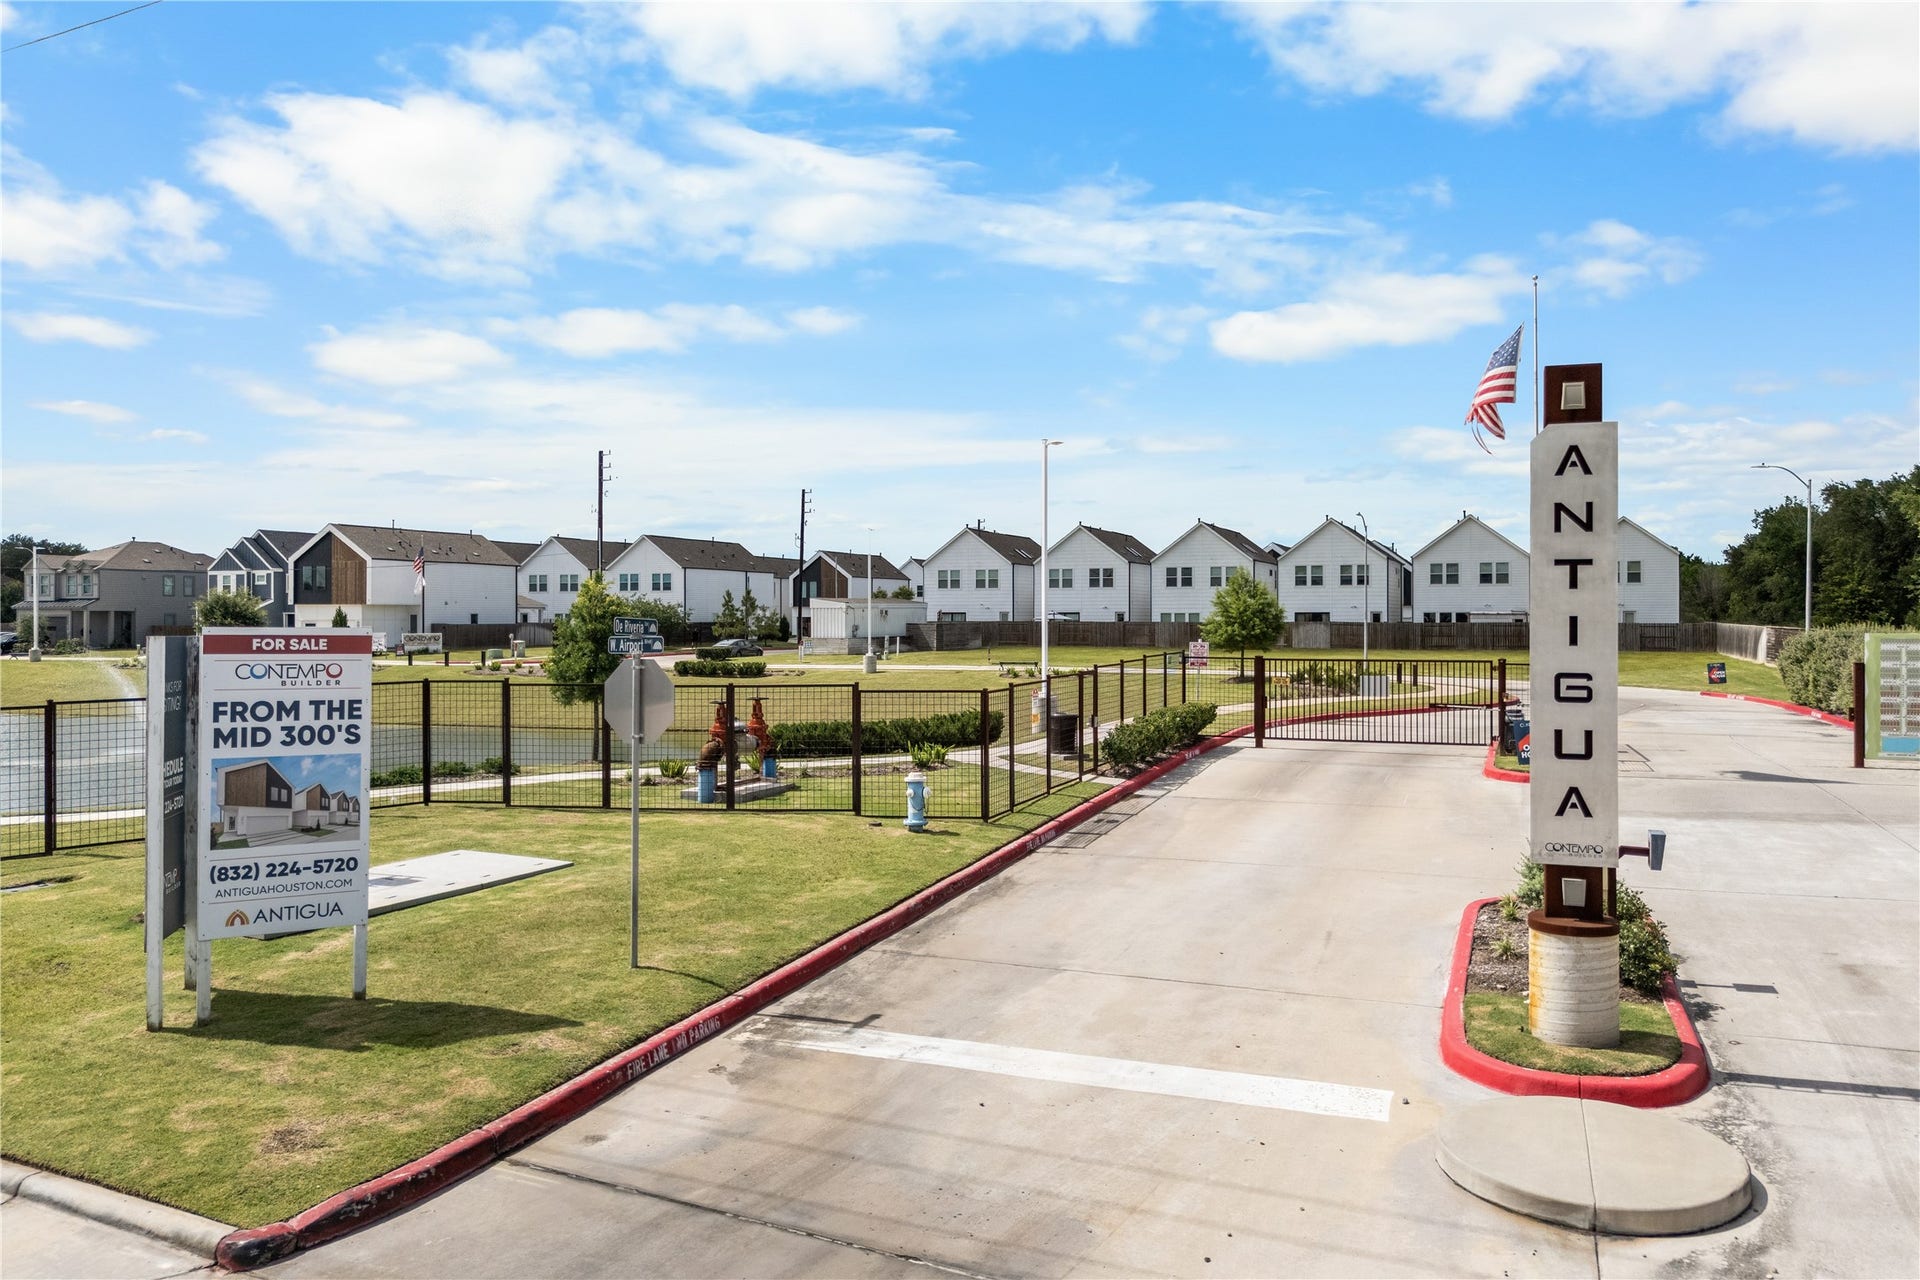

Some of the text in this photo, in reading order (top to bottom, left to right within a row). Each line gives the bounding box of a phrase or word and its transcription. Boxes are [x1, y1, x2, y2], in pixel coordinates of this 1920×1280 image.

[615, 620, 623, 633] De
[1554, 445, 1593, 818] ANTIGUA
[252, 638, 328, 651] FOR SALE
[610, 639, 618, 652] W.
[619, 639, 644, 653] Airport
[235, 663, 343, 680] CONTEMPO
[281, 679, 341, 687] BUILDER
[213, 700, 363, 723] FROM THE
[213, 724, 362, 749] MID 300'S
[164, 756, 184, 777] HEDULE
[1544, 842, 1604, 854] CONTEMPO
[210, 857, 359, 884] (832) 224-5720
[215, 878, 353, 898] ANTIGUAHOUSTON.COM
[253, 901, 344, 924] ANTIGUA
[627, 1056, 648, 1080] FIRE
[647, 1042, 670, 1067] LANE
[689, 1016, 720, 1043] PARKING
